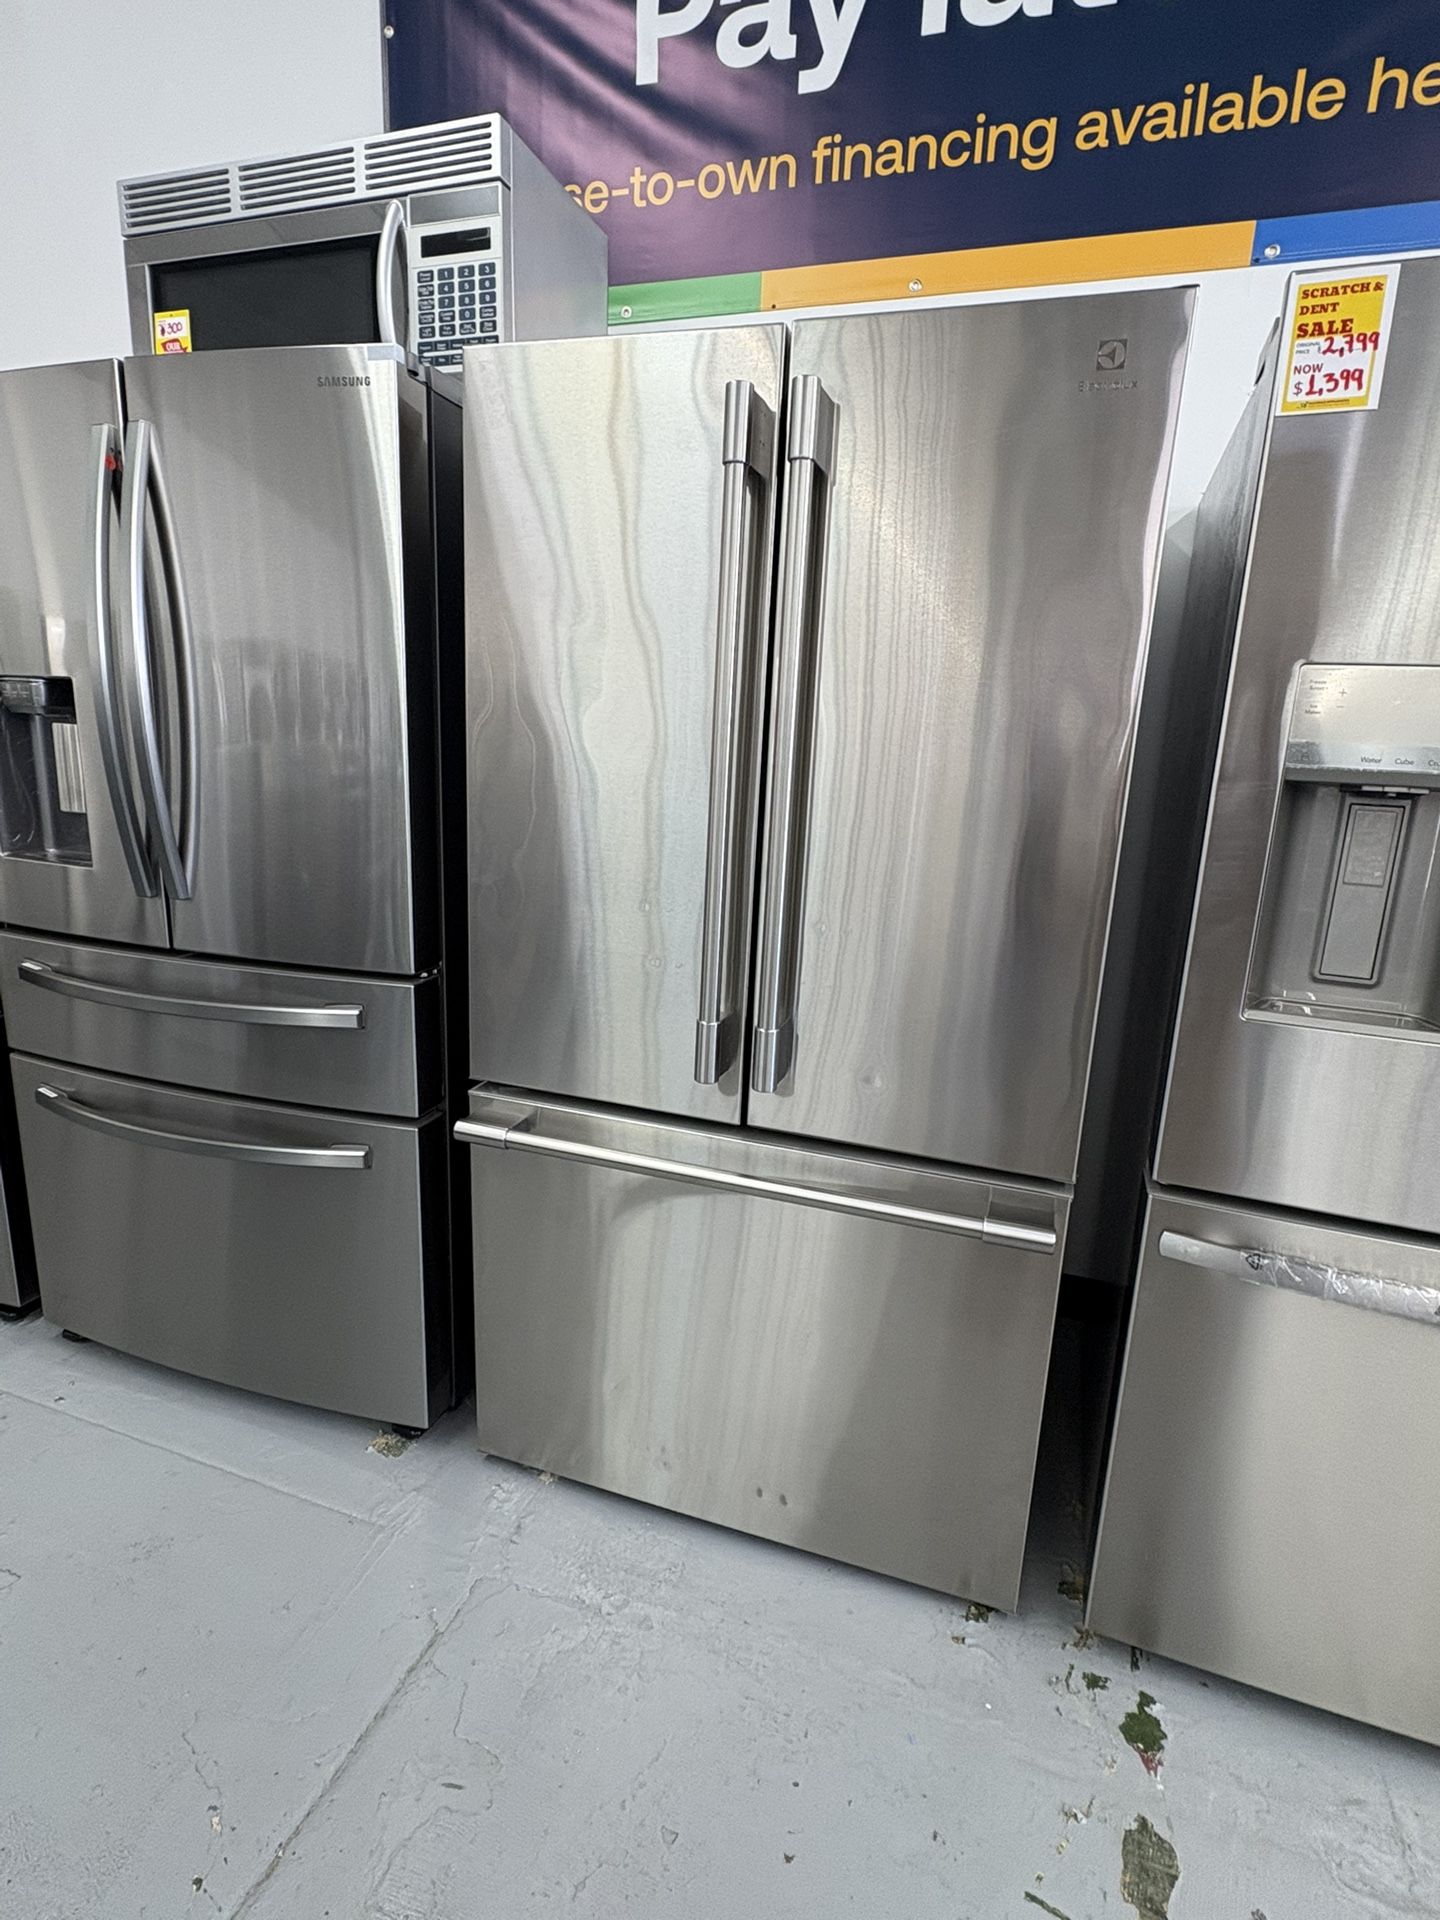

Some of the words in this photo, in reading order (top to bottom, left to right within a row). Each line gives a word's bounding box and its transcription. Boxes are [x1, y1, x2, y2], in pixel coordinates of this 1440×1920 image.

[811, 113, 1058, 171] financing
[1074, 68, 1347, 150] available
[1301, 282, 1372, 300] SCRATCH
[1373, 281, 1385, 291] &
[1299, 302, 1340, 316] DENT
[1296, 318, 1354, 339] SALE
[1293, 363, 1324, 375] NOW
[317, 376, 371, 387] SAMSUNG
[1394, 757, 1415, 766] Cube
